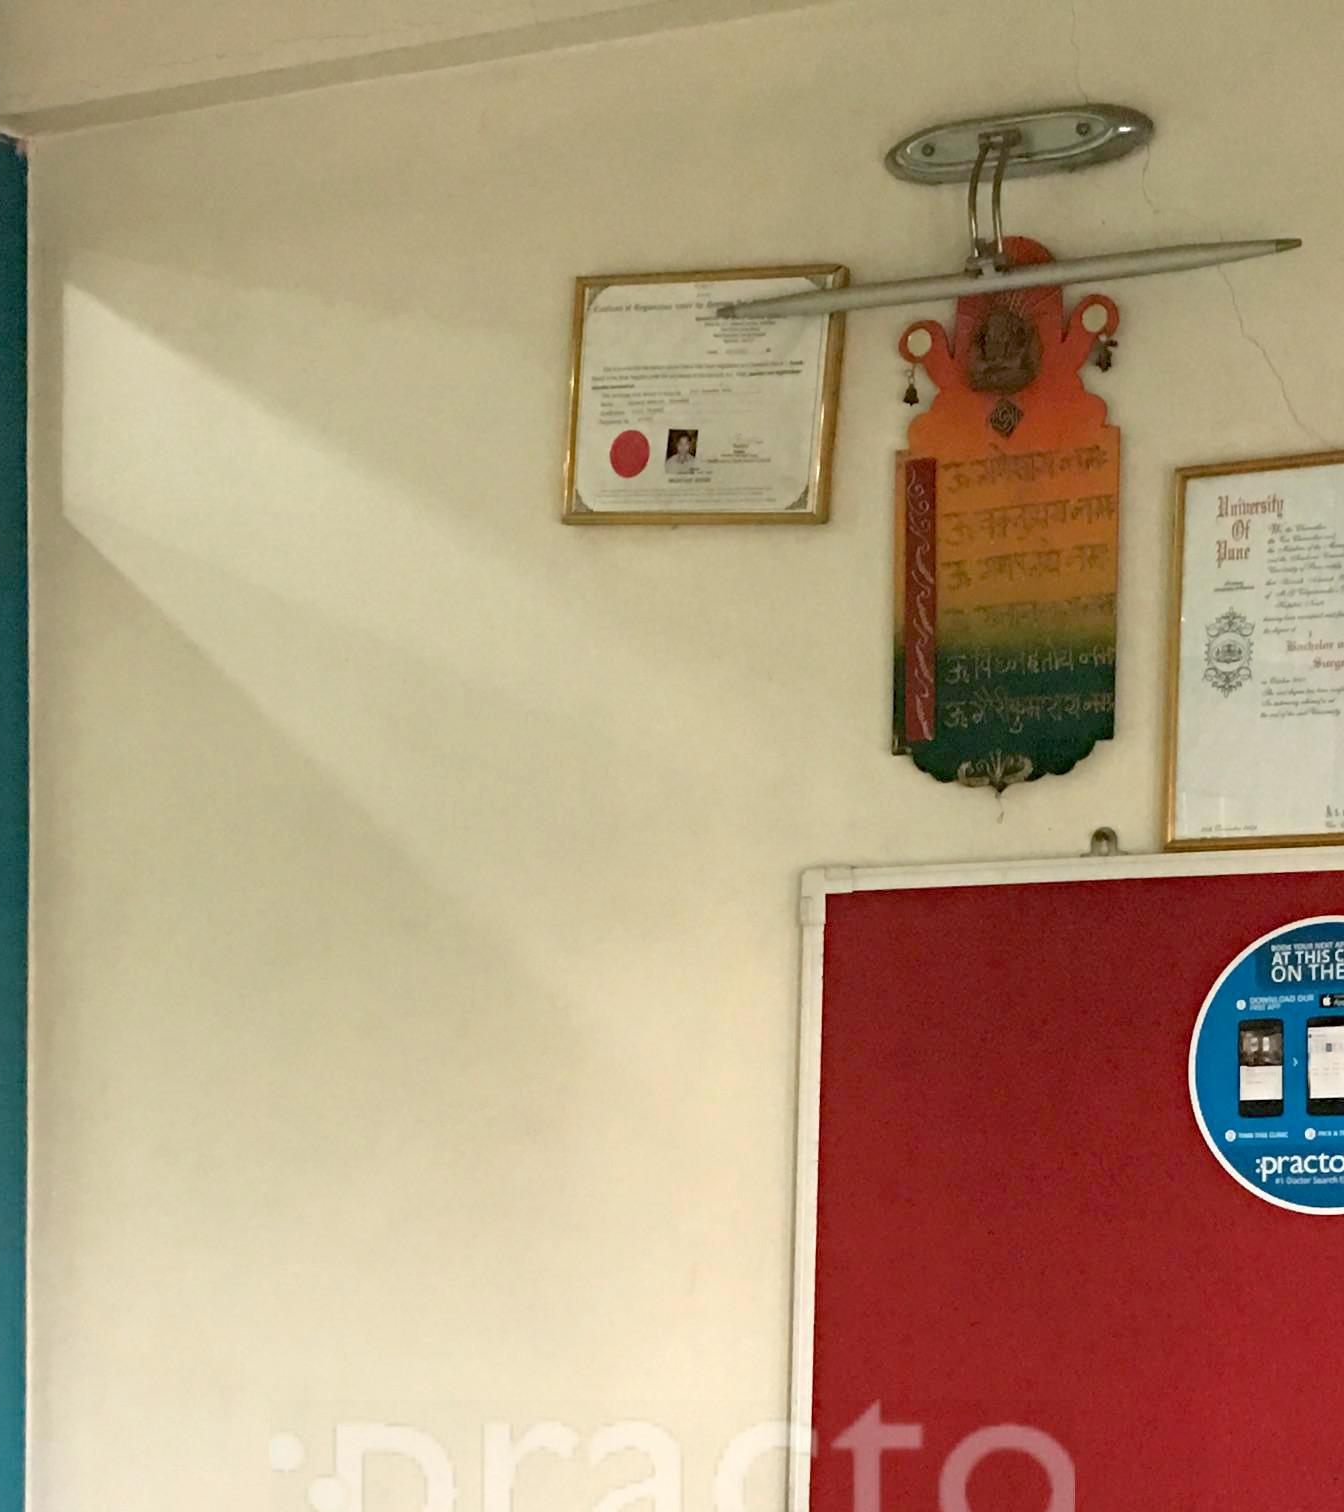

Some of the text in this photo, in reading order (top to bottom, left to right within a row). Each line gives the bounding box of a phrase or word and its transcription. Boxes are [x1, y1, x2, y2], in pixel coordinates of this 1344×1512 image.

[1216, 495, 1285, 519] University
[1231, 519, 1251, 540] Of
[1216, 540, 1251, 568] Pune
[1272, 951, 1291, 966] AT
[1295, 949, 1330, 963] THIS
[1271, 965, 1302, 983] ON
